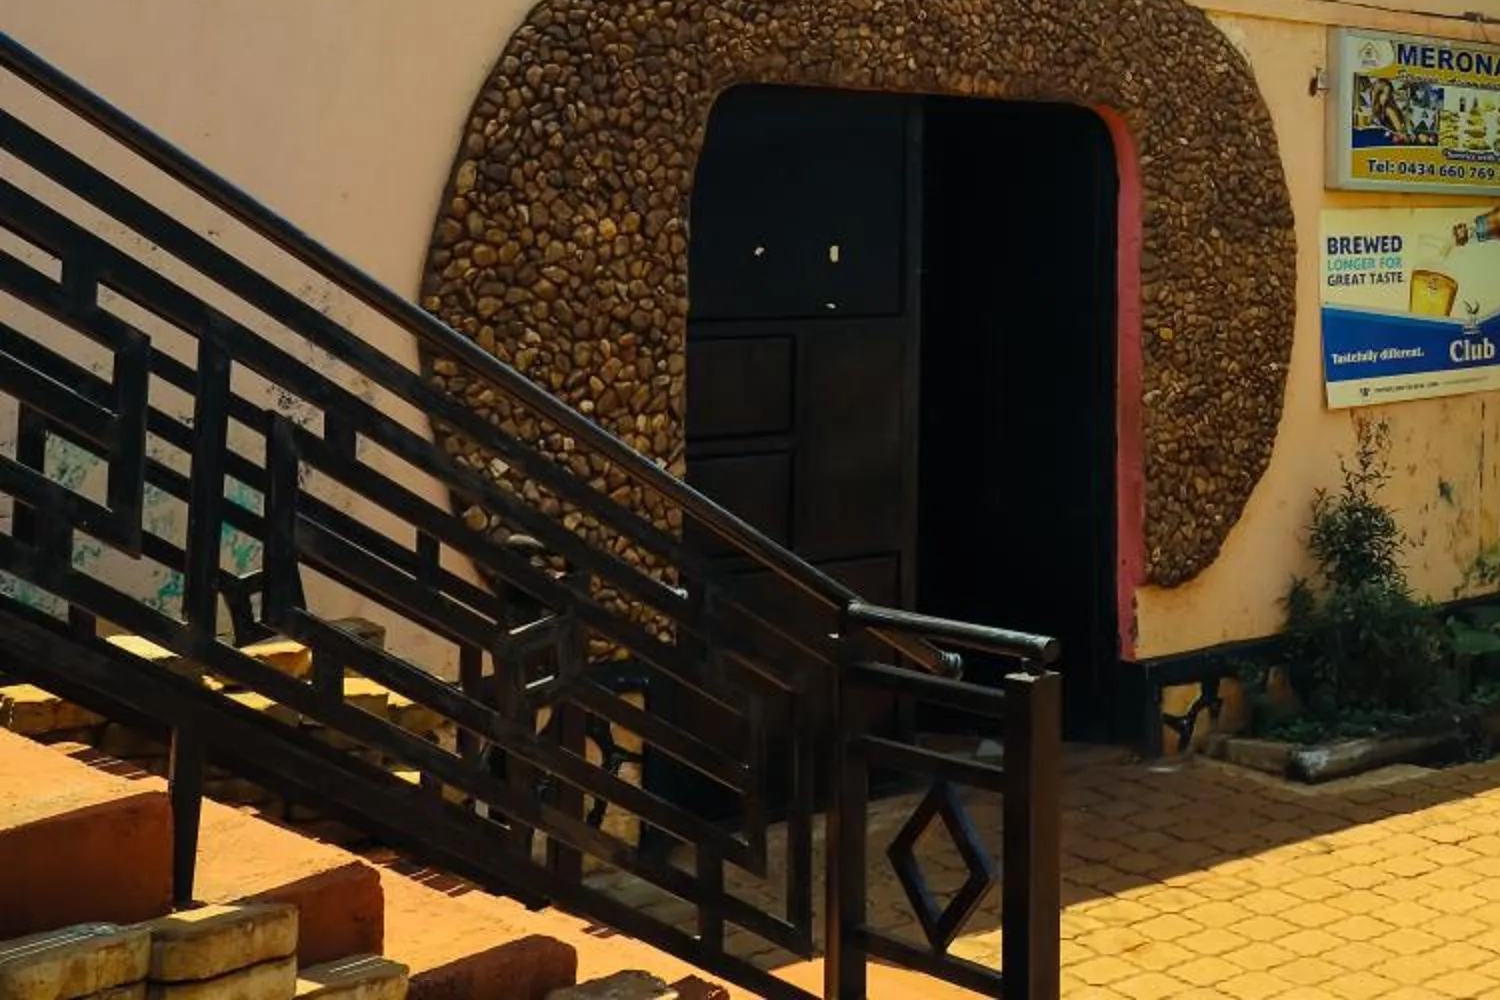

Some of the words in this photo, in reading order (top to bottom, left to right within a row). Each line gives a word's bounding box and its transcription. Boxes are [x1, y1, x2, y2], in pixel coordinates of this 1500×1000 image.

[1368, 159, 1394, 173] Tel:
[1470, 167, 1495, 180] 769
[1327, 235, 1403, 255] BREWED
[1328, 258, 1376, 271] LONGER
[1379, 256, 1403, 269] FOR
[1327, 274, 1367, 287] GREAT
[1450, 337, 1495, 362] Club
